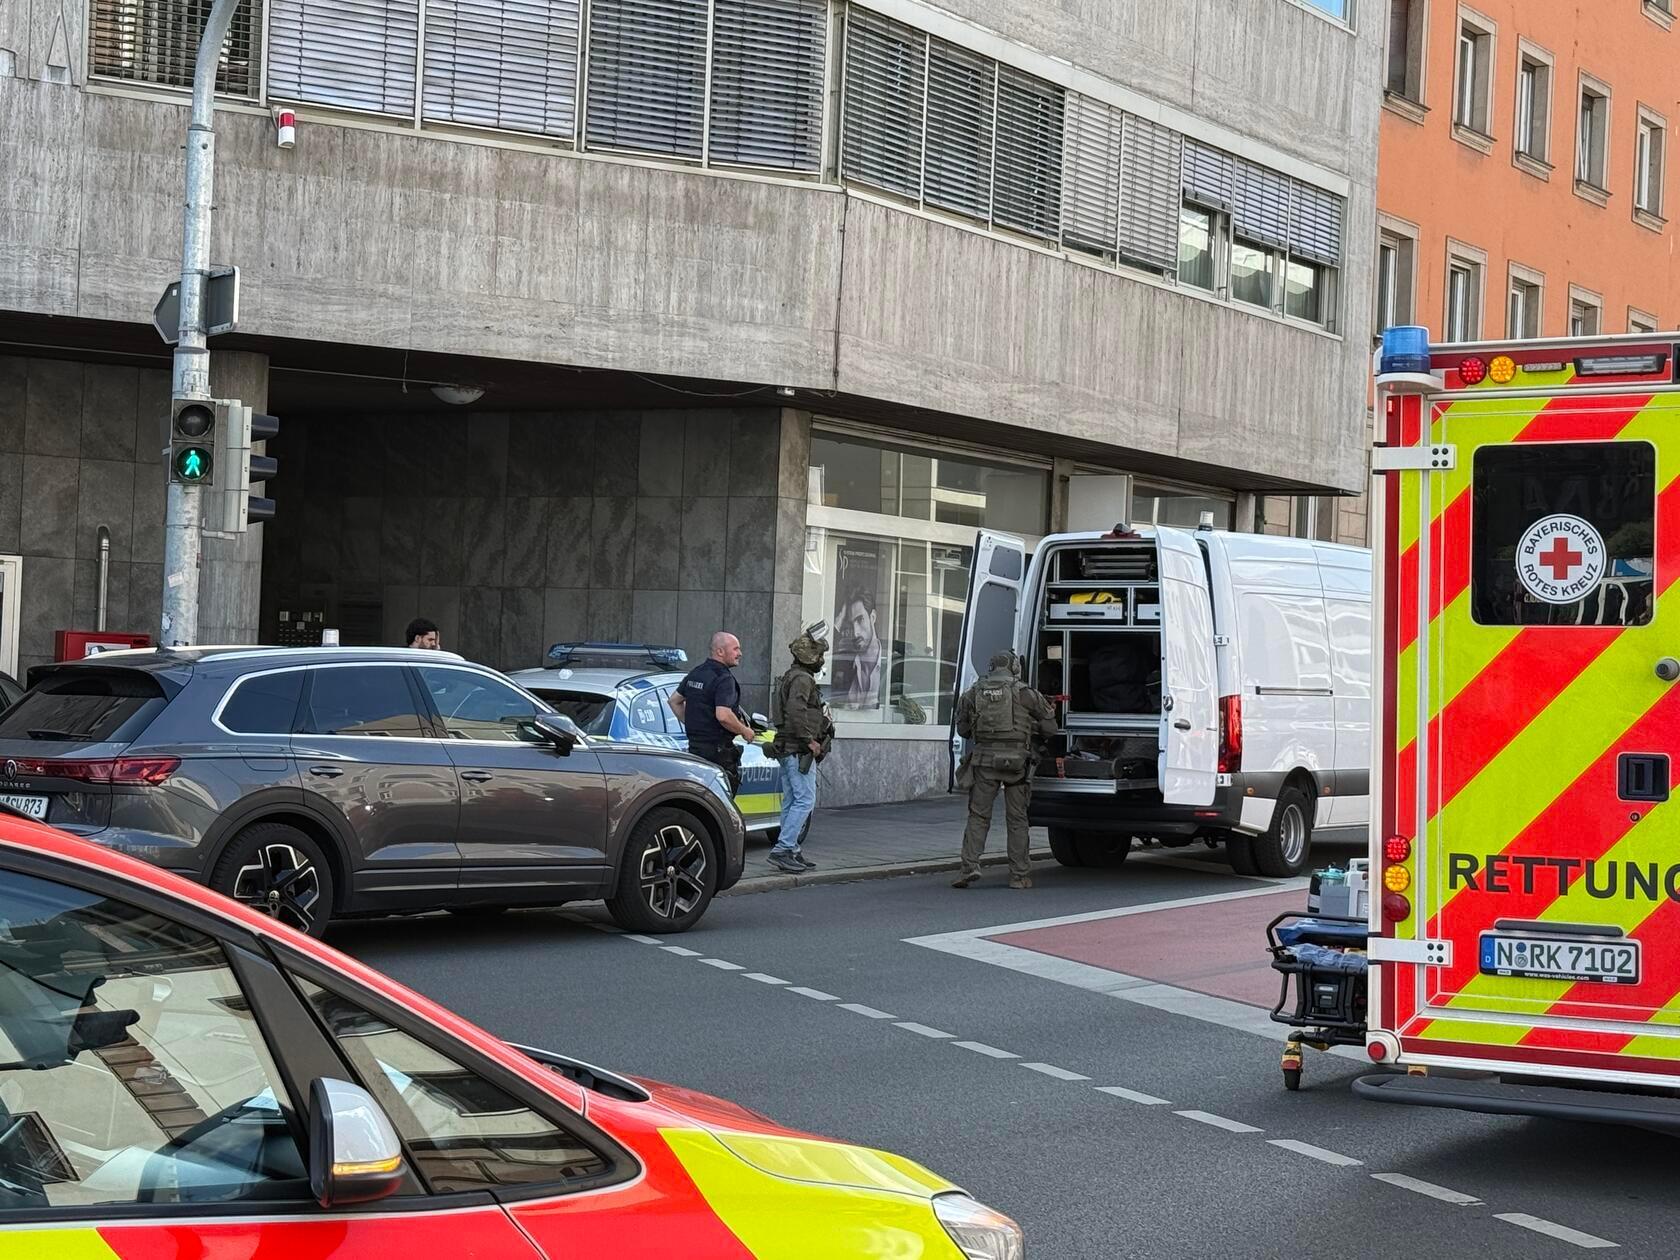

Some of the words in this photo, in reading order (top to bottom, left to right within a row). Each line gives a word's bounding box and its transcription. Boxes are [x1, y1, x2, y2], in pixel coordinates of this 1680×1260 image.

[1524, 521, 1598, 555] BAYERISCHES
[1523, 563, 1558, 596] ROTES
[1561, 563, 1598, 596] KREUZ
[741, 766, 772, 782] POLIZEI
[23, 798, 42, 815] 873
[1497, 942, 1513, 966] N
[1530, 943, 1562, 970] RK
[1568, 946, 1633, 974] 7102
